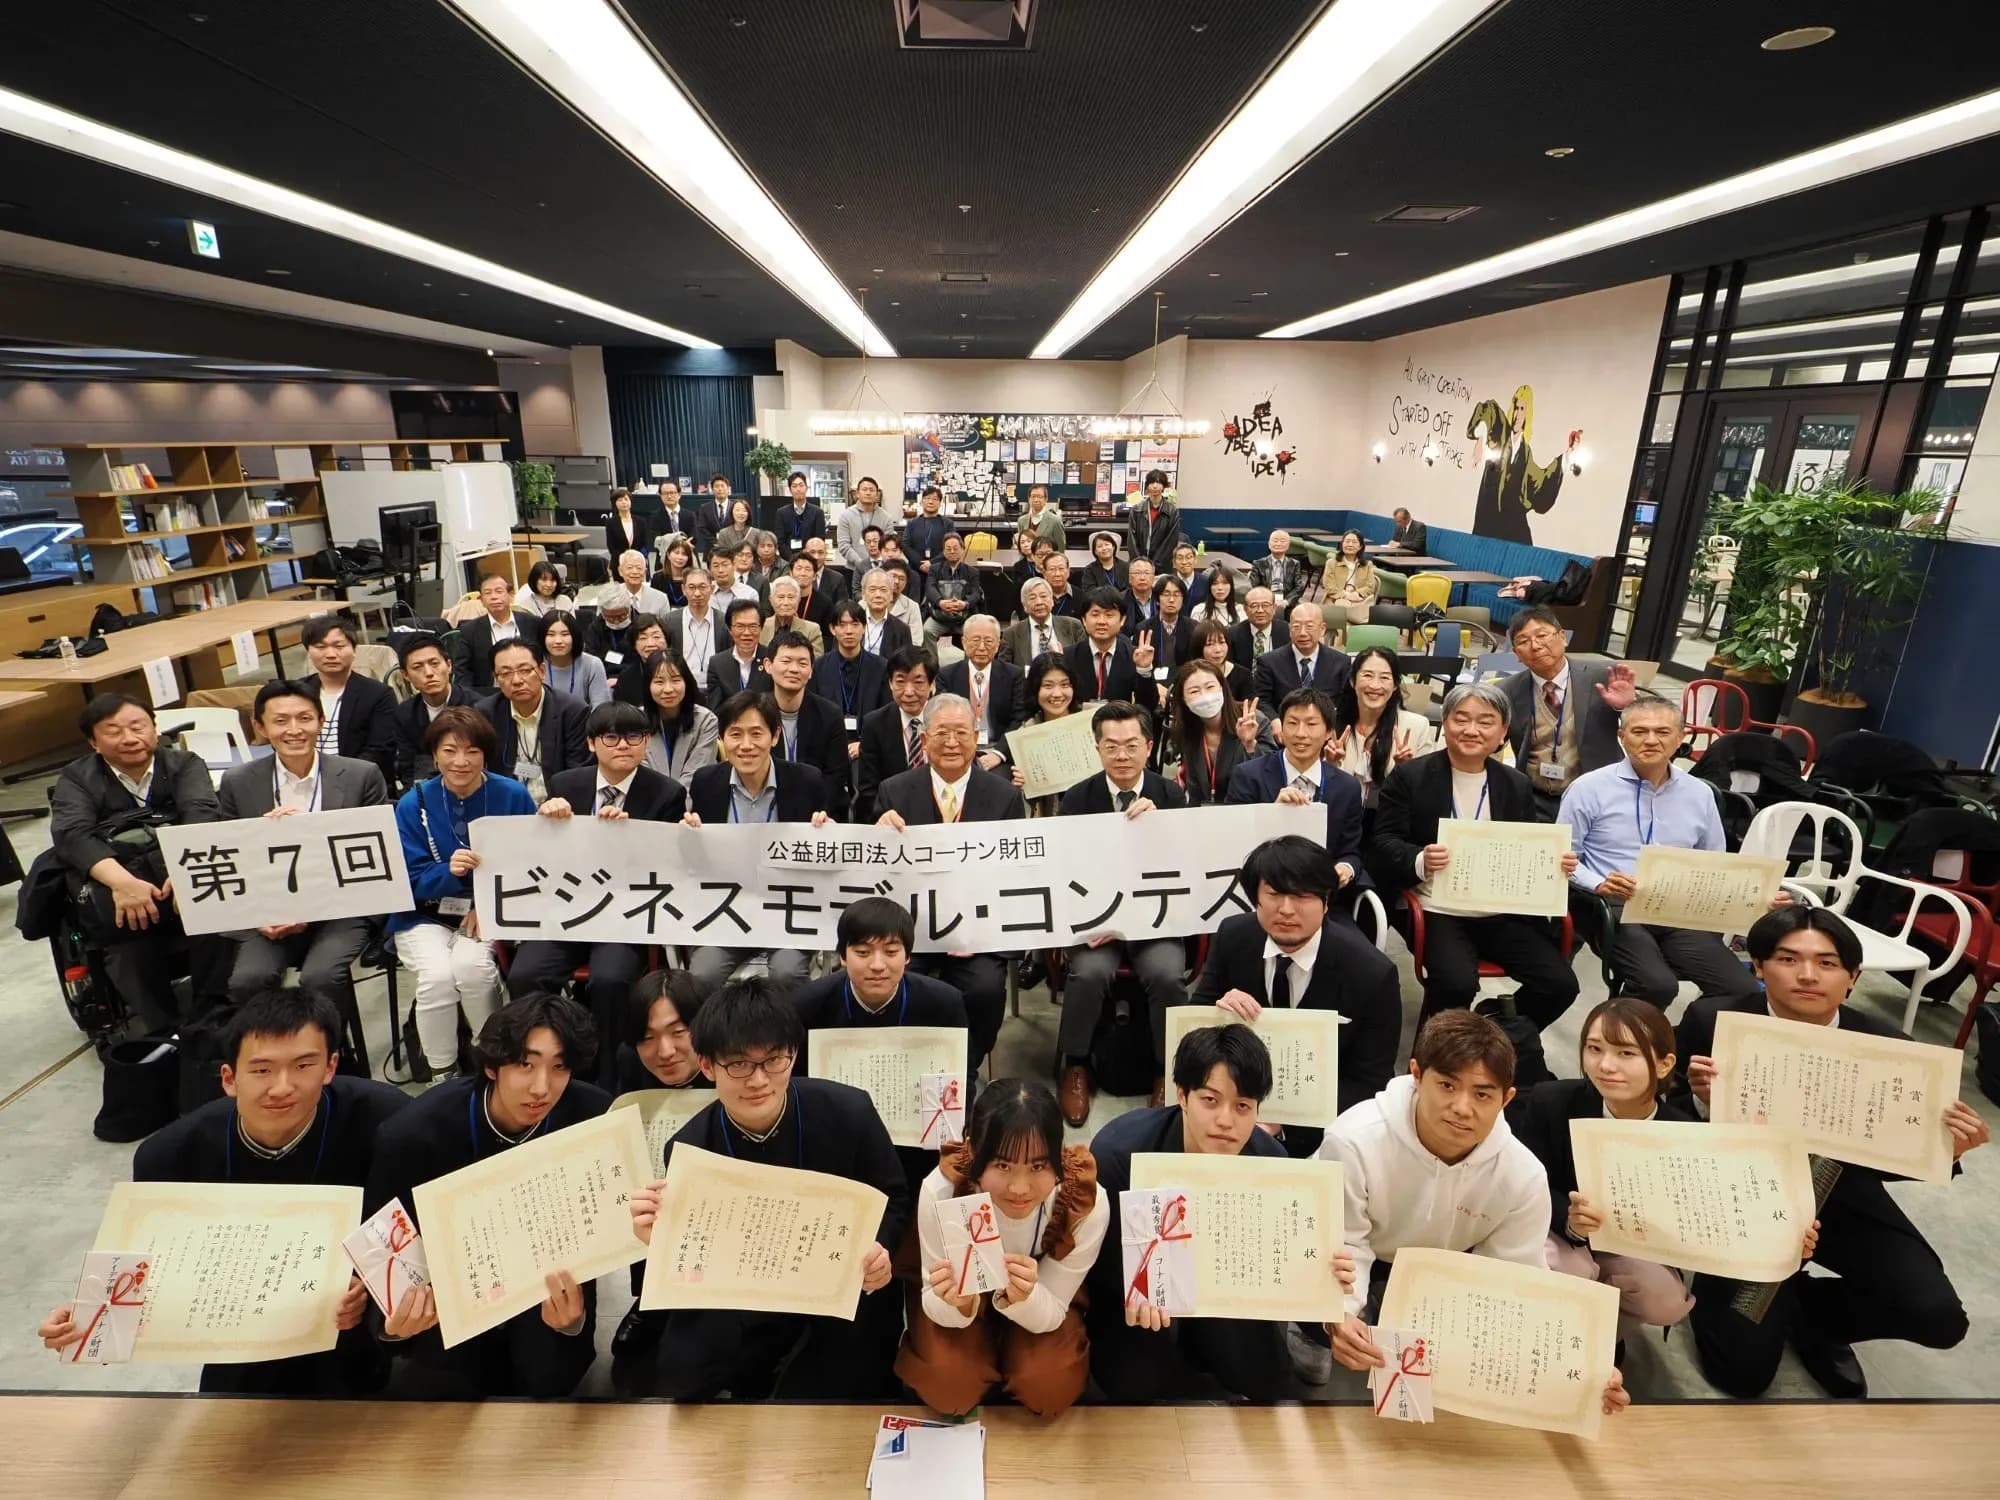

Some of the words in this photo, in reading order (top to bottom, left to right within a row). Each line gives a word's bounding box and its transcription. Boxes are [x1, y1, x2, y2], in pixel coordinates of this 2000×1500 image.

[1389, 395, 1429, 435] STARTED
[1433, 411, 1453, 437] OFF
[178, 829, 395, 905] 第7回
[766, 835, 1046, 867] 公益財団法人コーナン財団
[493, 864, 1254, 942] ビジネスモル・コンテス
[1154, 1257, 1166, 1308] コーナン財団
